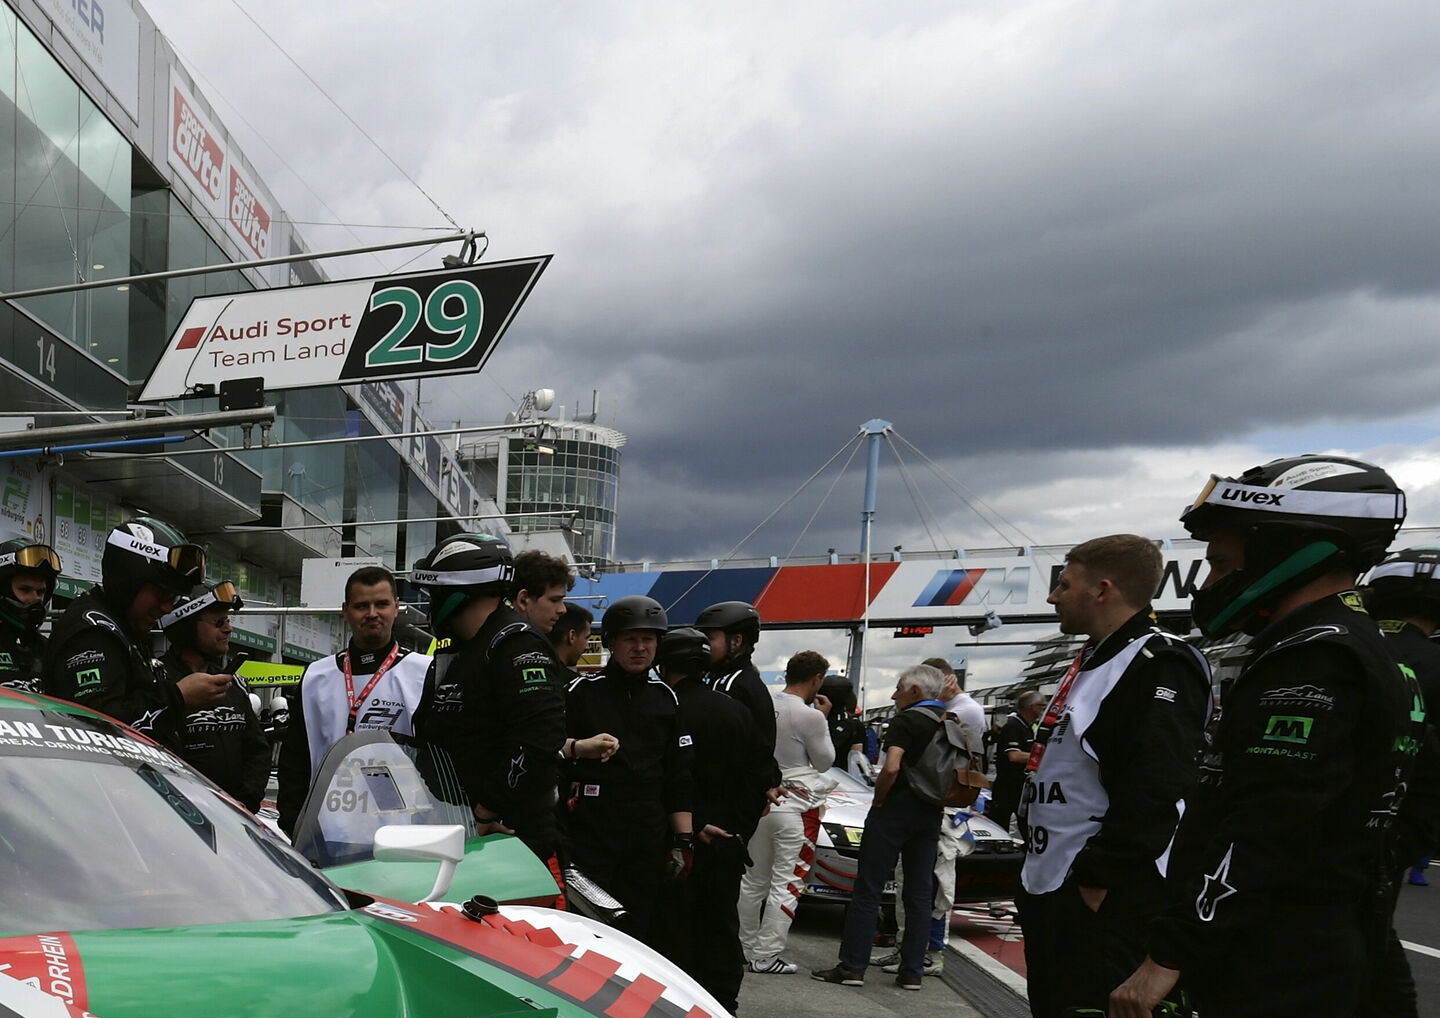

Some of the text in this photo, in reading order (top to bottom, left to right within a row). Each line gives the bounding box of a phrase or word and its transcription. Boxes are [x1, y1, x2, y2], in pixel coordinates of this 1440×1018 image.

[180, 103, 207, 146] sport
[176, 122, 222, 201] auto
[235, 177, 257, 216] sport
[231, 194, 269, 258] auto
[209, 313, 352, 343] Audi Sport
[364, 279, 485, 368] 29
[36, 336, 56, 382] 14
[209, 338, 346, 368] Team Land
[213, 456, 224, 485] 13
[1221, 488, 1285, 506] uvex
[129, 539, 162, 557] uvex
[414, 572, 439, 583] uvex
[174, 599, 207, 618] uvex
[44, 724, 184, 768] TURISMO
[44, 741, 111, 756] DRIVING
[326, 789, 369, 814] 691
[37, 934, 74, 1006] DRHEIN
